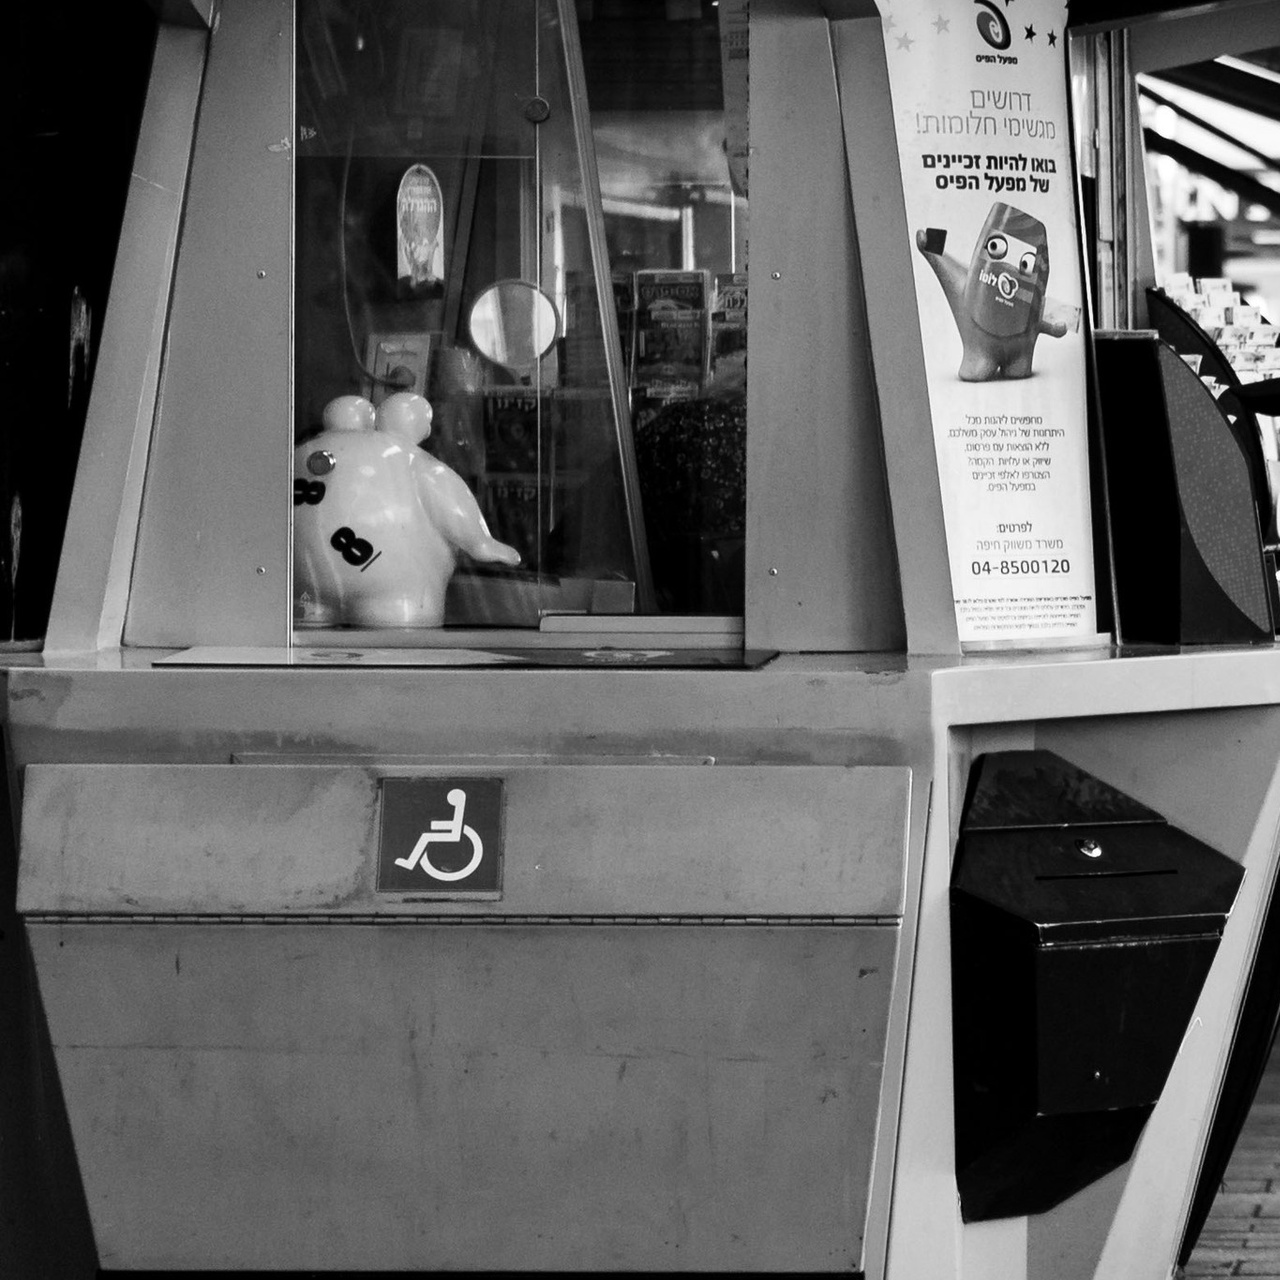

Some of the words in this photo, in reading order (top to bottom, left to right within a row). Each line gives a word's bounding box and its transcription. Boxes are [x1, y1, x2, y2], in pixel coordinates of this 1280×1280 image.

[976, 54, 996, 63] הפיס
[997, 54, 1018, 65] מפעל
[971, 89, 1032, 112] דרושים
[915, 110, 998, 136] חלומות!
[1003, 117, 1056, 140] מגשימי
[922, 154, 982, 170] זכיינים
[985, 153, 1027, 172] להיות
[1031, 157, 1057, 174] בואו
[935, 174, 980, 190] הפיס
[984, 172, 1026, 193] מפעל
[1030, 175, 1050, 193] של
[979, 269, 998, 287] לוטו
[497, 398, 537, 413] קזינו
[965, 414, 982, 425] מכל
[984, 414, 1009, 425] ליהנות
[1010, 415, 1043, 425] מחפשים
[979, 429, 997, 440] עסק
[998, 427, 1017, 438] ניהול
[1019, 427, 1031, 438] של
[1034, 441, 1050, 452] ללא
[1022, 457, 1031, 466] או
[997, 469, 1020, 480] לאלפי
[1021, 471, 1051, 480] הצטרפו
[1009, 481, 1036, 492] במפעל
[996, 520, 1033, 534] לפרטים:
[976, 540, 1001, 551] חיפה
[1003, 539, 1033, 554] משווק
[1035, 538, 1064, 550] משרד
[971, 558, 1071, 576] 04-8500120
